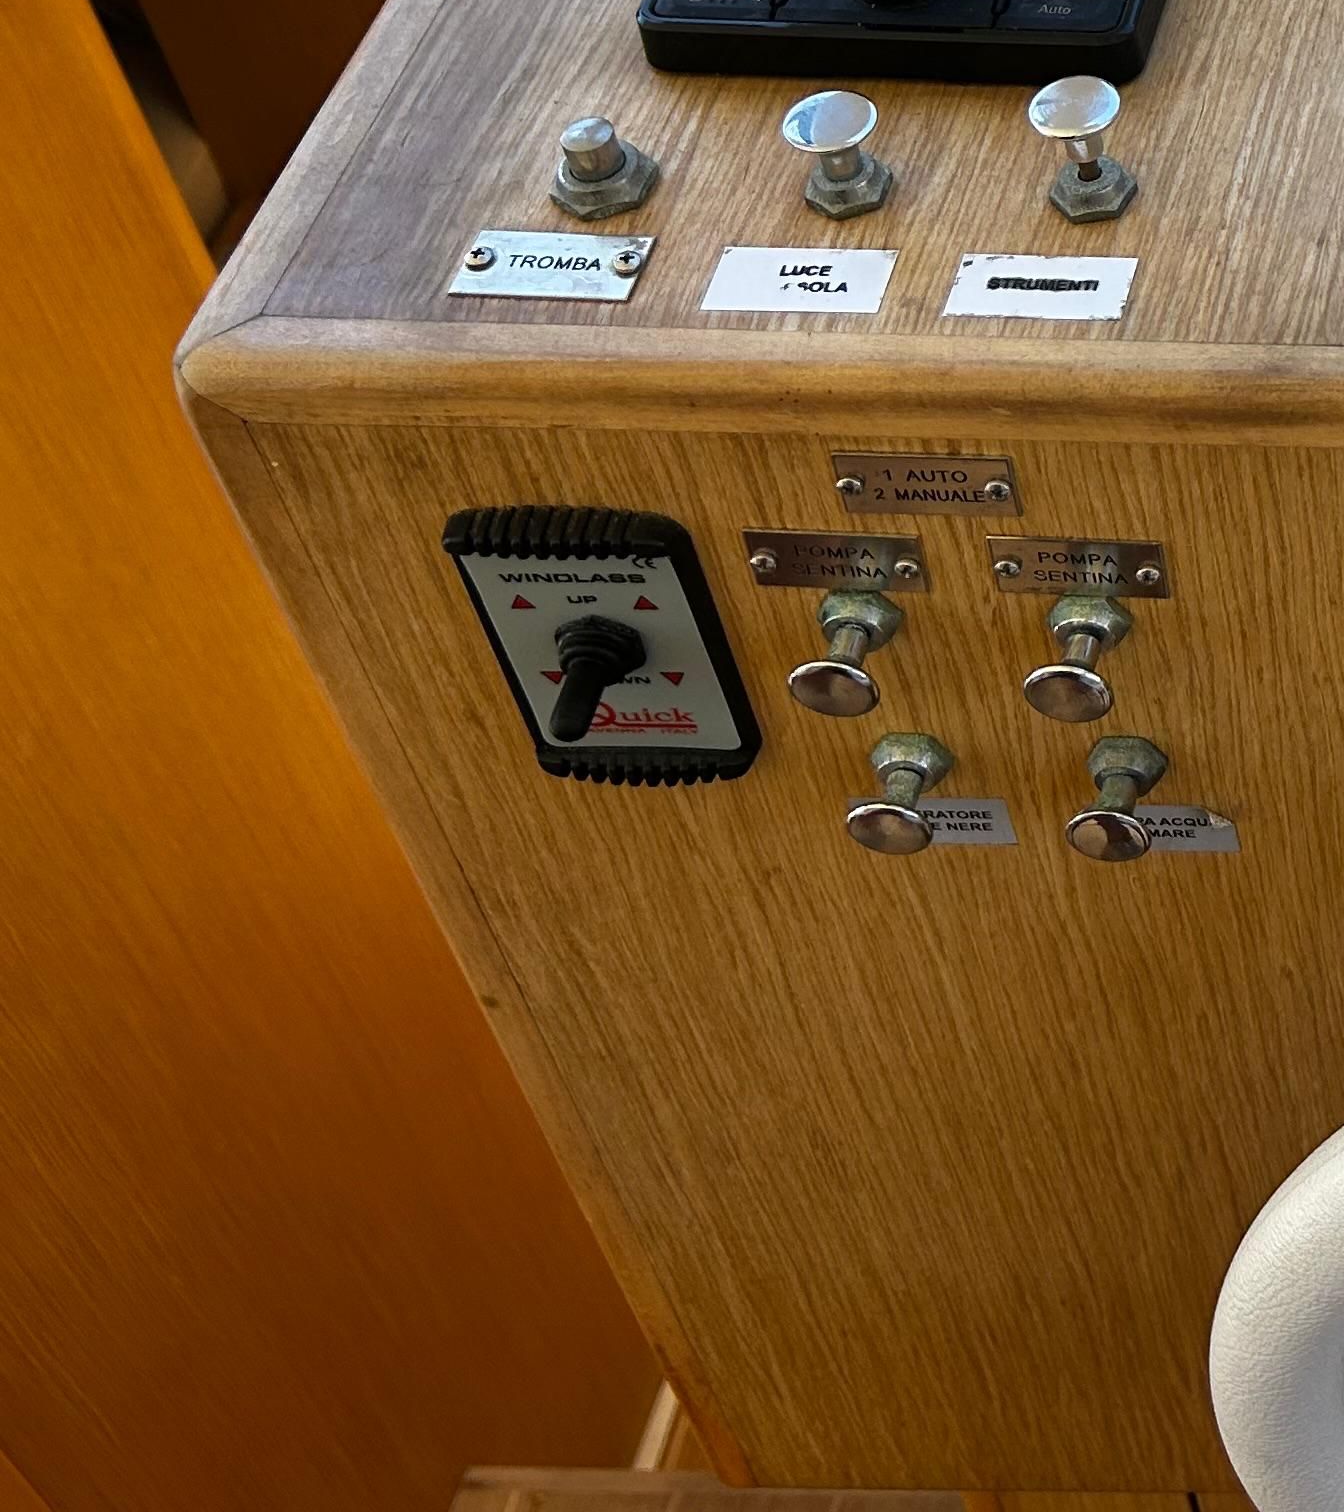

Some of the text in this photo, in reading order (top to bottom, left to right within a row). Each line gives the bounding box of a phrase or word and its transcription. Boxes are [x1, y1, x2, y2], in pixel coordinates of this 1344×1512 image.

[1037, 2, 1073, 17] Auto
[508, 254, 602, 272] TROMBA
[779, 264, 833, 277] LUCE
[986, 276, 1099, 292] STRUMENTI
[906, 469, 969, 485] AUTO
[874, 488, 987, 504] 2 MANUALE
[793, 544, 876, 561] POMPA
[1037, 551, 1119, 567] POMPA
[498, 573, 647, 585] WINDLASS
[791, 562, 889, 580] SENTINA
[1033, 569, 1130, 586] SENTINA
[566, 595, 598, 605] UP
[592, 701, 697, 728] Quick
[945, 822, 993, 831] NERE
[1160, 817, 1213, 827] ACQU
